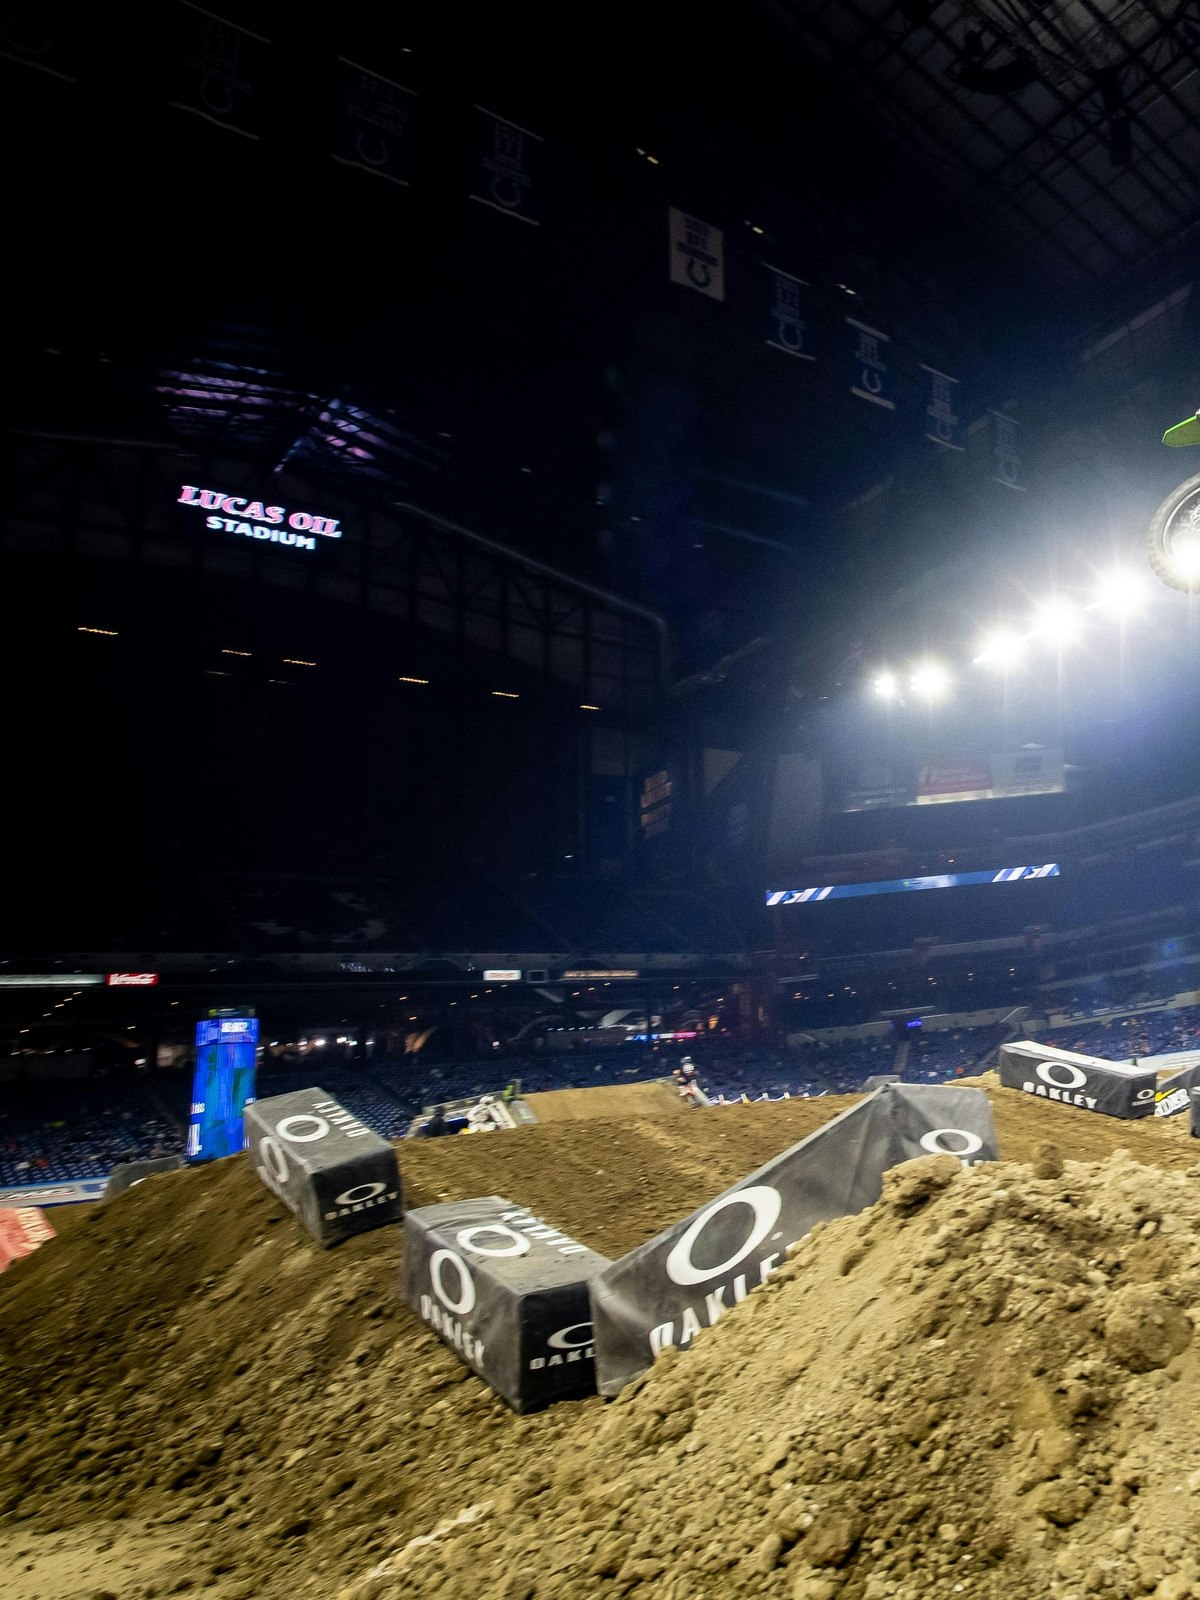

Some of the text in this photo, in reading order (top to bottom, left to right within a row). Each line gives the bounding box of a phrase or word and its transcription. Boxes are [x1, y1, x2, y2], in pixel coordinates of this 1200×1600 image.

[177, 485, 342, 538] LUCAS OIL
[206, 516, 316, 550] STADIUM
[1022, 1081, 1097, 1109] OAKLEY
[324, 1190, 399, 1221] OAKLEY
[650, 1232, 812, 1357] OAKLE
